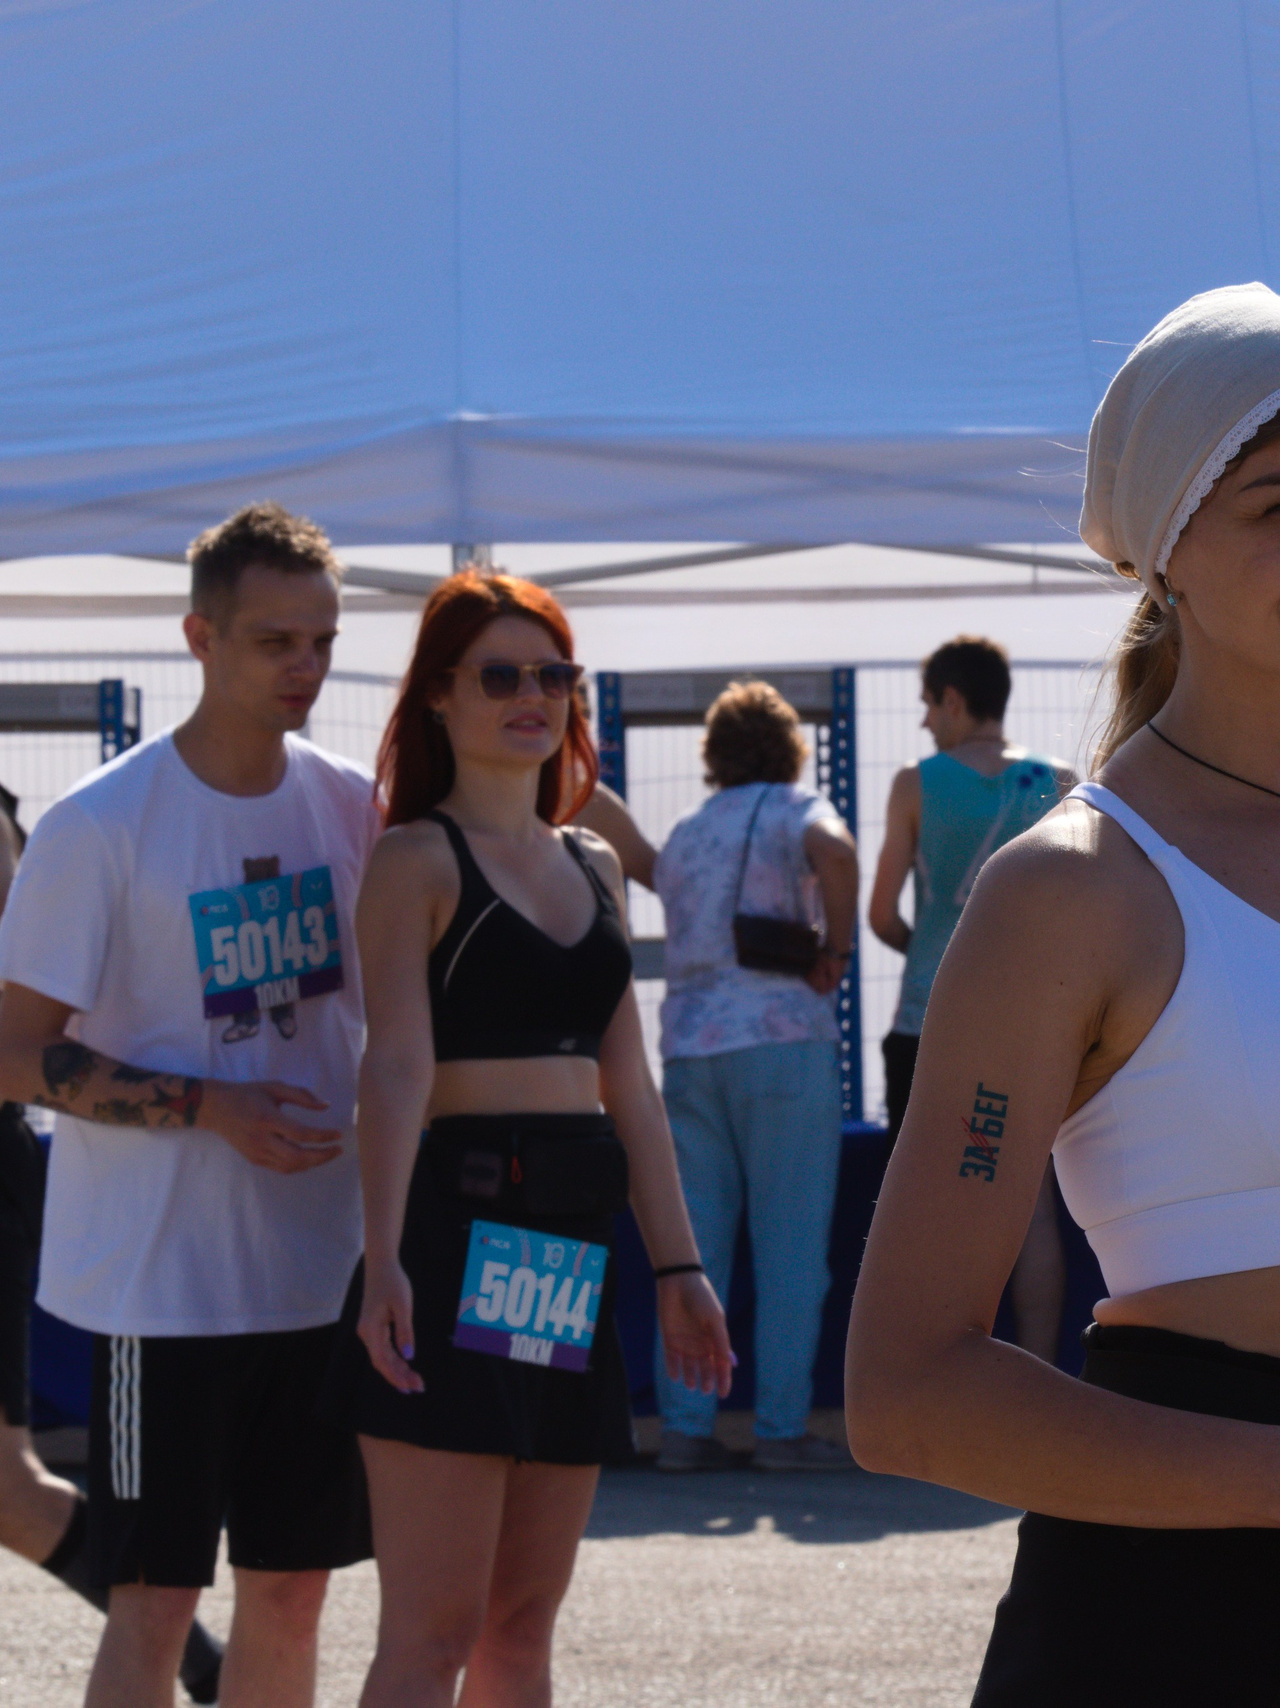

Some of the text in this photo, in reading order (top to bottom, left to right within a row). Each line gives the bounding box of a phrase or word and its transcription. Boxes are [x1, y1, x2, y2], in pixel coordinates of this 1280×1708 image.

[210, 905, 329, 986] 50143
[255, 976, 301, 1009] 10KM
[959, 1082, 1009, 1182] ЗАБЕГ
[475, 1260, 592, 1340] 50144
[509, 1332, 555, 1367] 10KM
